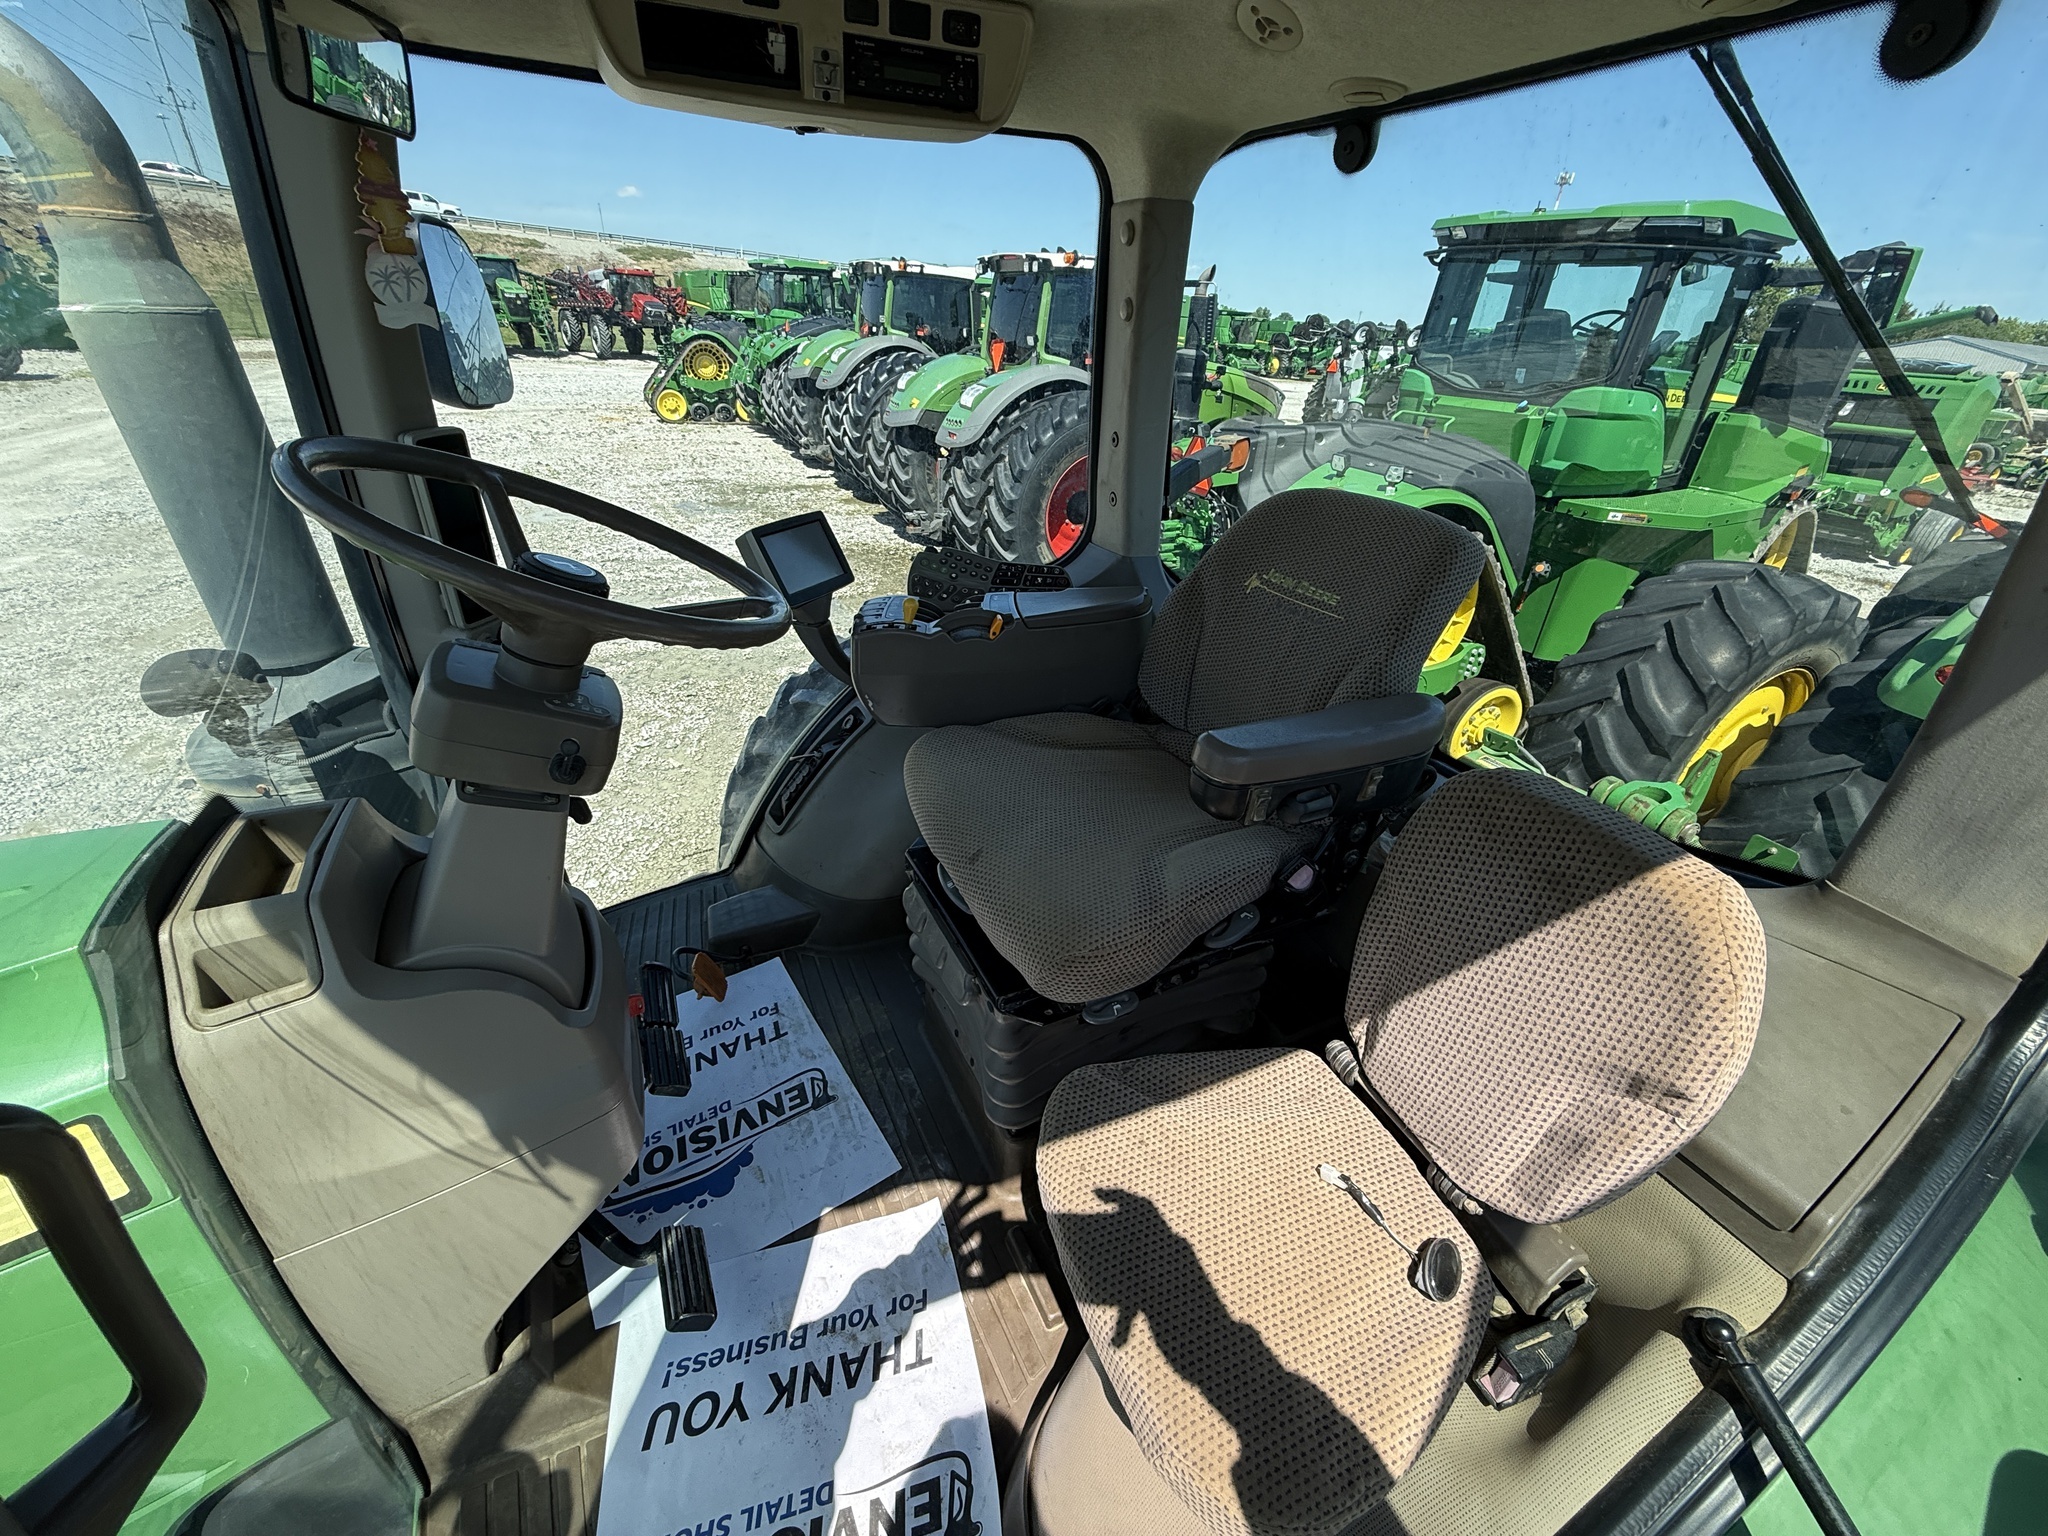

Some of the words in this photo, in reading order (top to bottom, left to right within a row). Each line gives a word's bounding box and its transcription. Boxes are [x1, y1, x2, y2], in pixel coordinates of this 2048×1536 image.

[1295, 580, 1341, 606] DEERE
[700, 1016, 746, 1041] Your
[749, 1002, 780, 1021] For
[687, 1020, 789, 1075] THAN
[666, 1099, 732, 1136] DETAIL
[816, 1304, 880, 1338] Your
[886, 1288, 928, 1317] For
[661, 1323, 810, 1389] Business!
[763, 1328, 933, 1416] THANK
[640, 1380, 750, 1452] YOU
[739, 1479, 835, 1533] DETAIL
